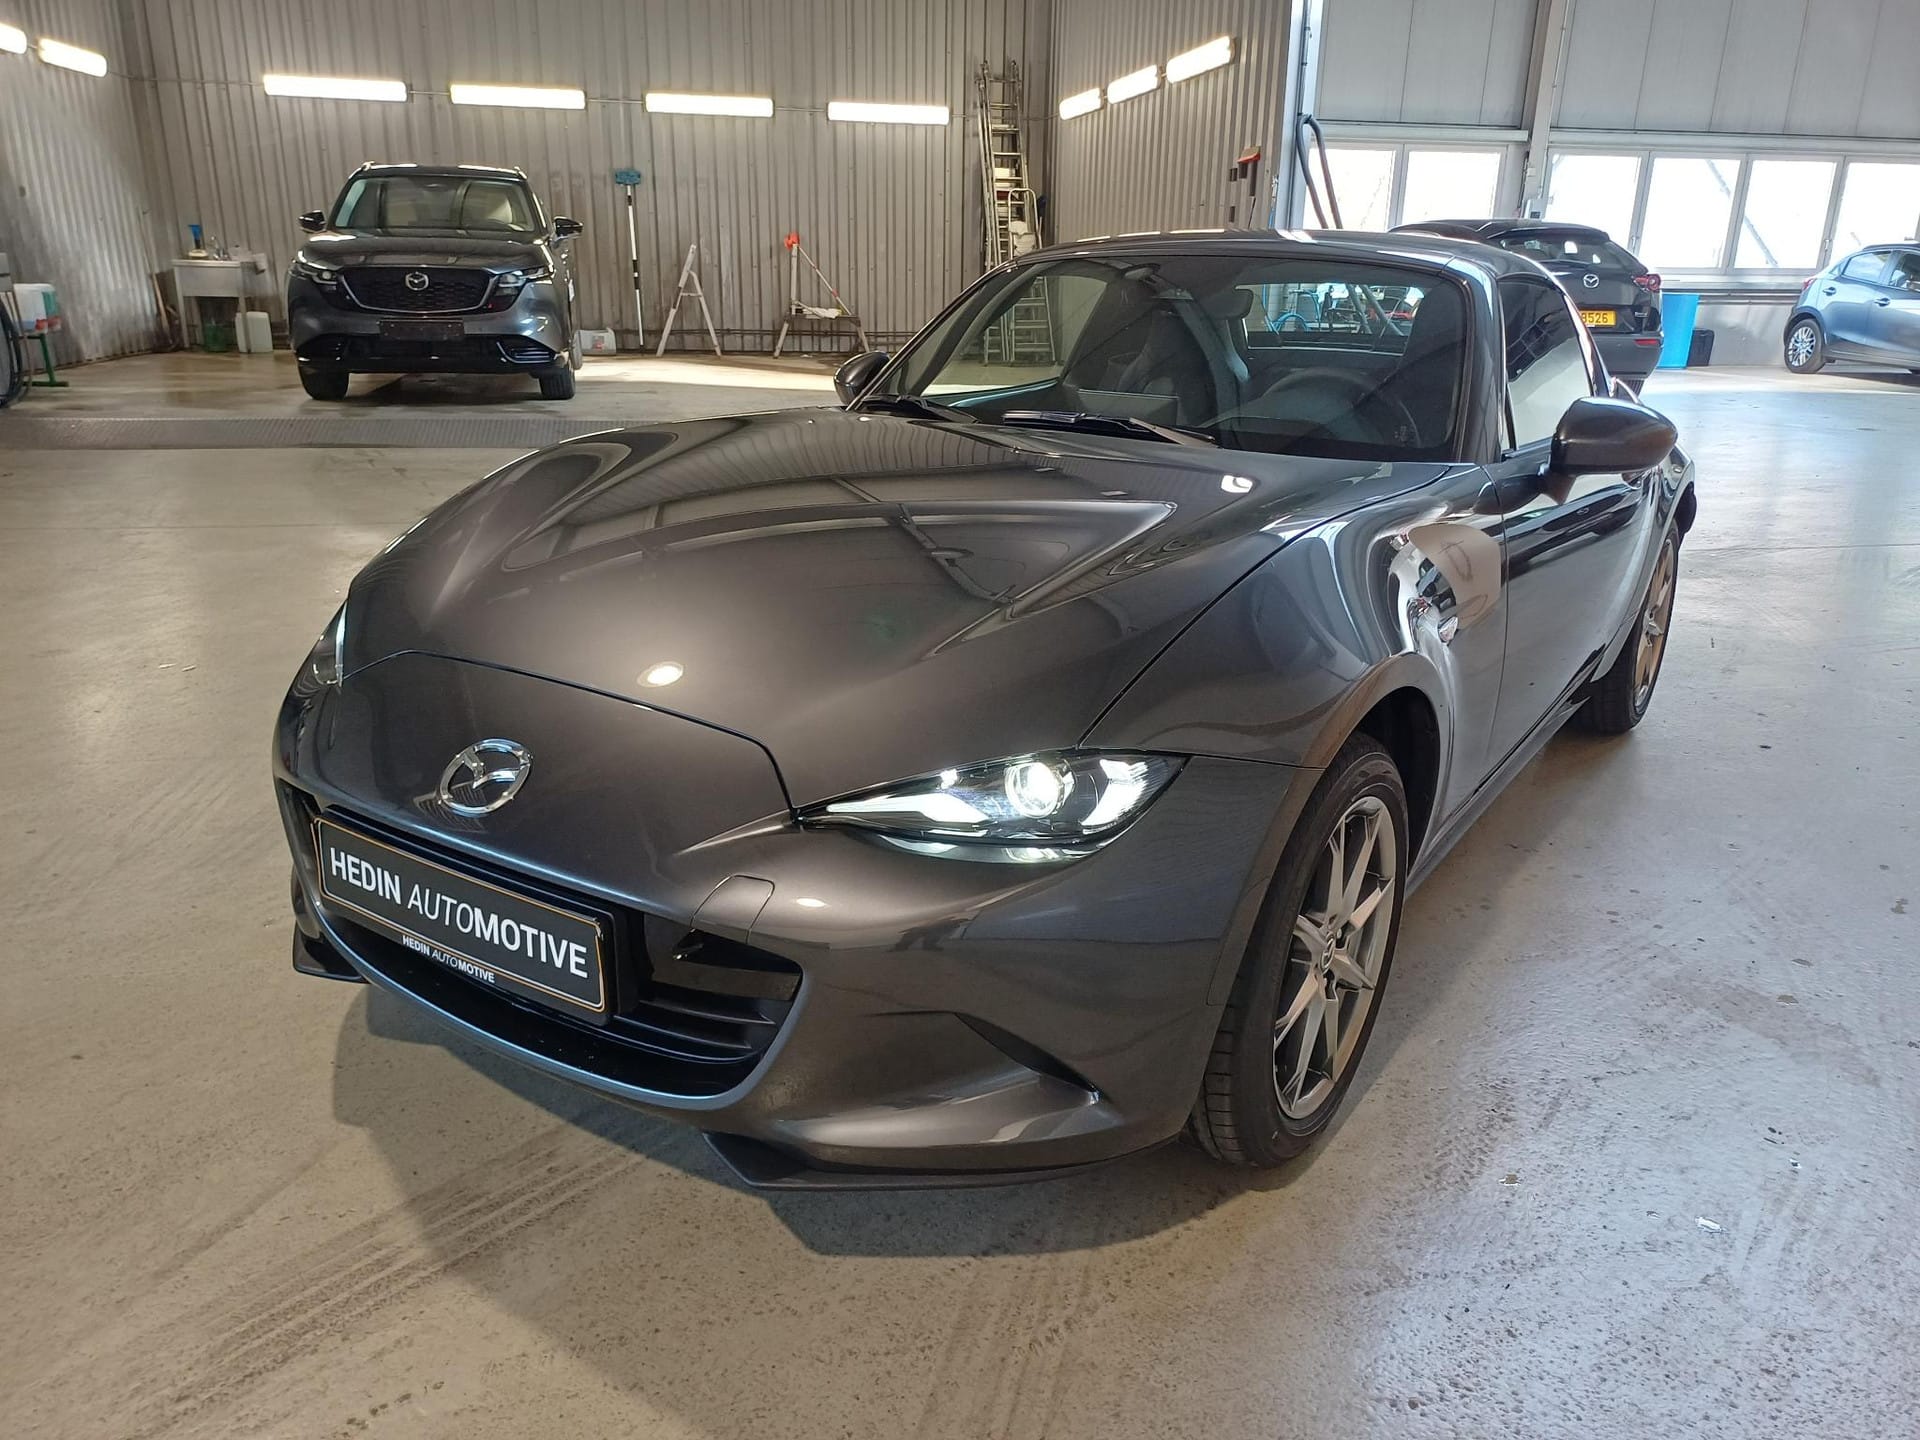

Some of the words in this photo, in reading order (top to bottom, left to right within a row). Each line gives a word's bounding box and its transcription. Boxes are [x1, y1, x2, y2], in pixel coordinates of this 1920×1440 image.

[330, 847, 401, 905] HEDIN
[408, 883, 589, 978] AUTOMOTIVE
[402, 935, 430, 956] HEDIN
[431, 943, 495, 983] AUTOMOTIVE
